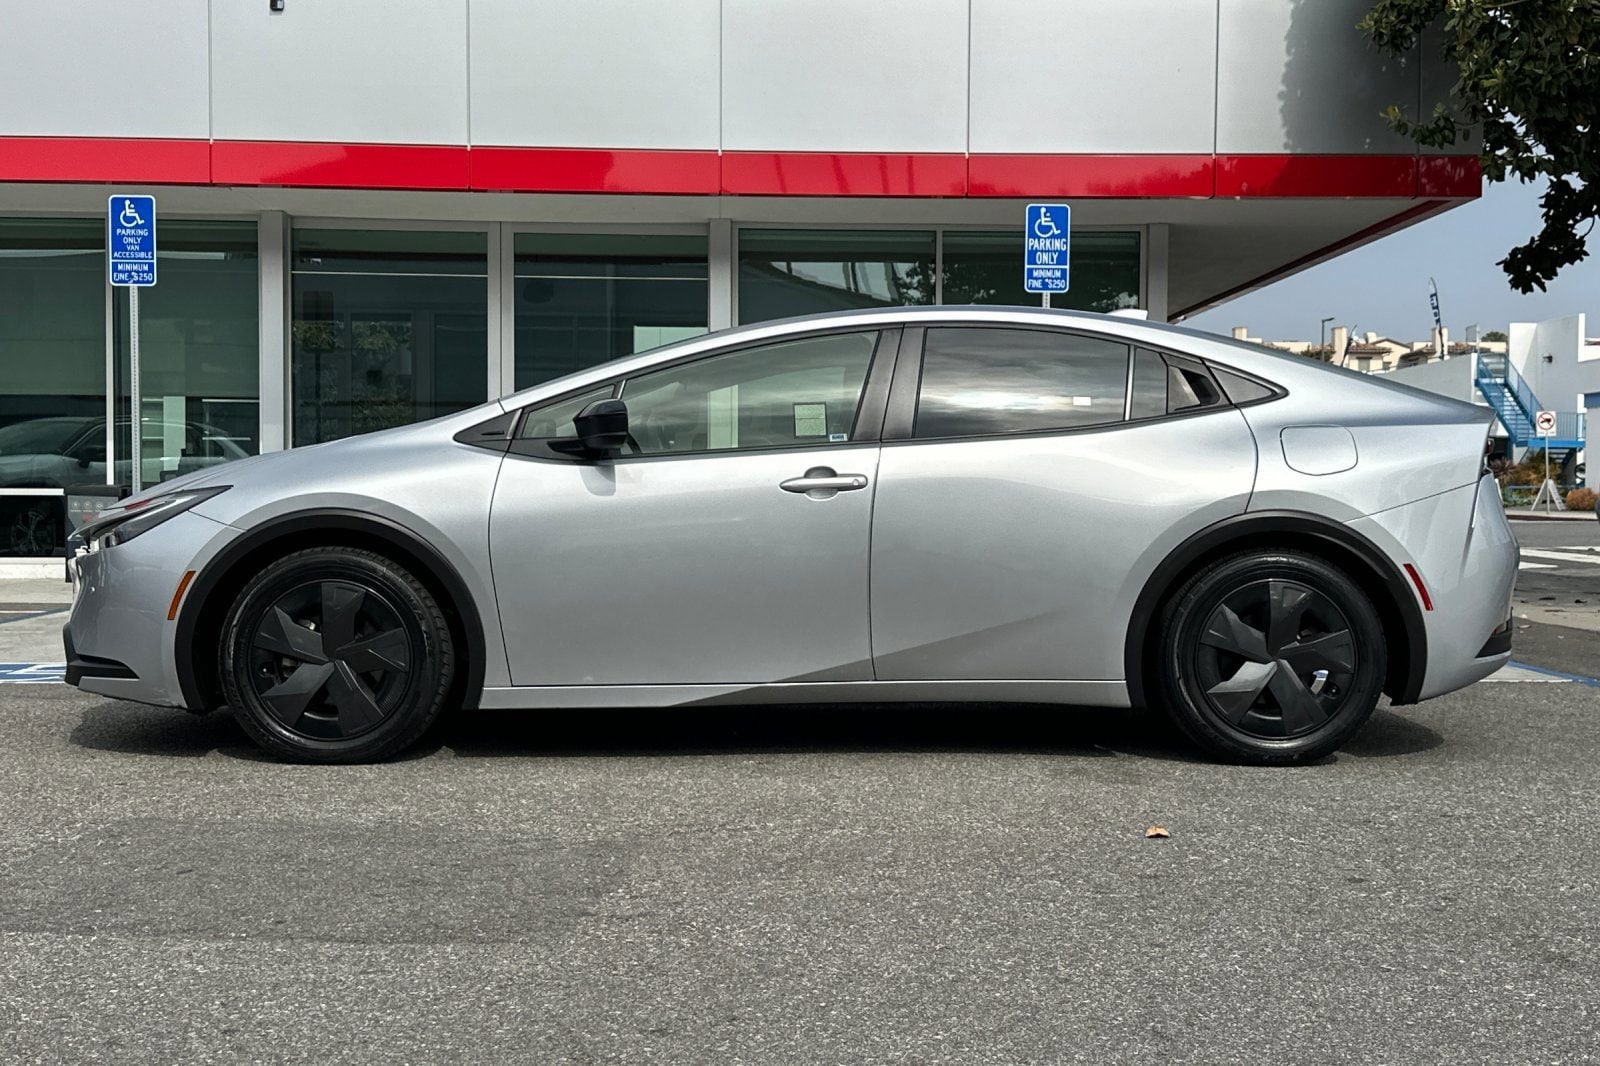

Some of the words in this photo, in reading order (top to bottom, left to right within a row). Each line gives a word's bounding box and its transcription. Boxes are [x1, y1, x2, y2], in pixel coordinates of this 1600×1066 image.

[116, 228, 149, 237] PARKING
[122, 236, 142, 244] ONLY
[1028, 238, 1067, 251] PARKING
[113, 251, 153, 259] ACCESSIBLE
[1035, 251, 1059, 265] ONLY
[117, 263, 149, 271] MINIMUM
[113, 272, 130, 281] FINE
[131, 272, 153, 281] $250
[1032, 269, 1062, 278] MINIMUM
[1027, 279, 1043, 288] FINE
[1047, 279, 1066, 288] $250
